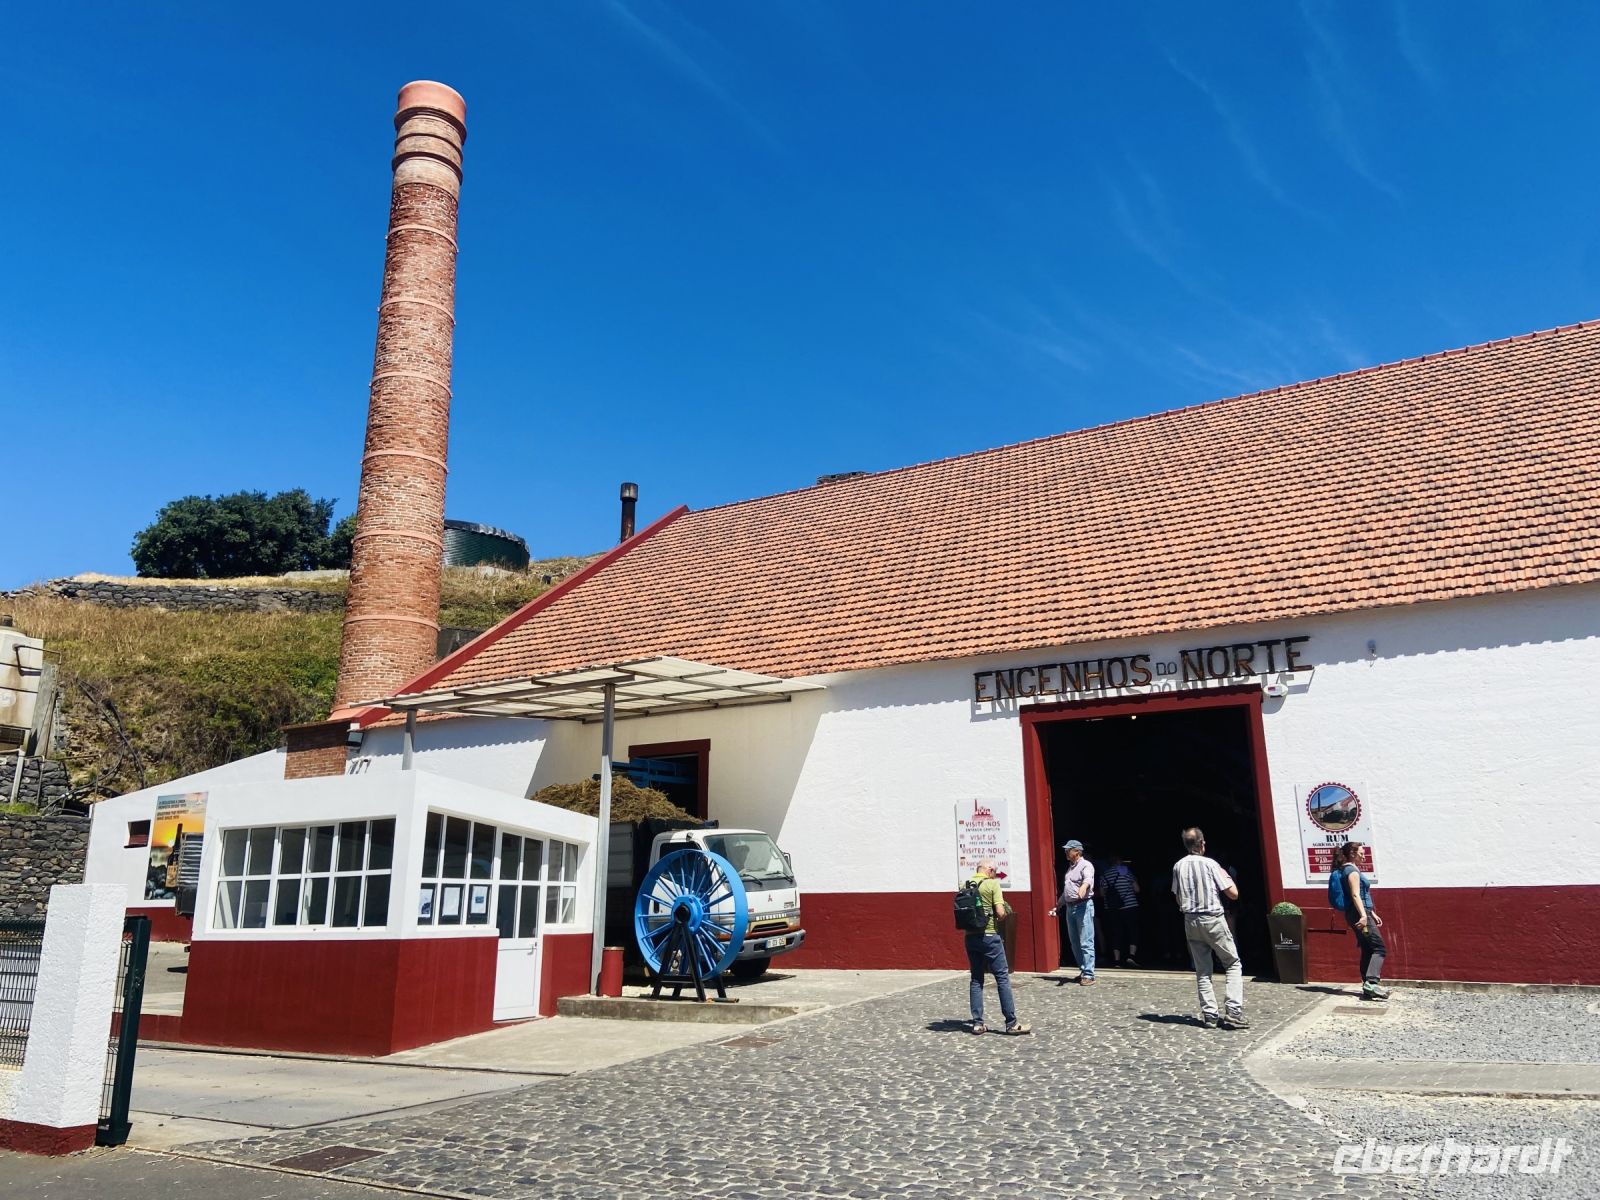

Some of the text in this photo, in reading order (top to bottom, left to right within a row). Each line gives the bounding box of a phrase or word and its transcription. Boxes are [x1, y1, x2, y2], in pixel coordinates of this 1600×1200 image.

[974, 636, 1314, 702] ENGENHOS DO NORTE
[1326, 834, 1349, 843] RUM
